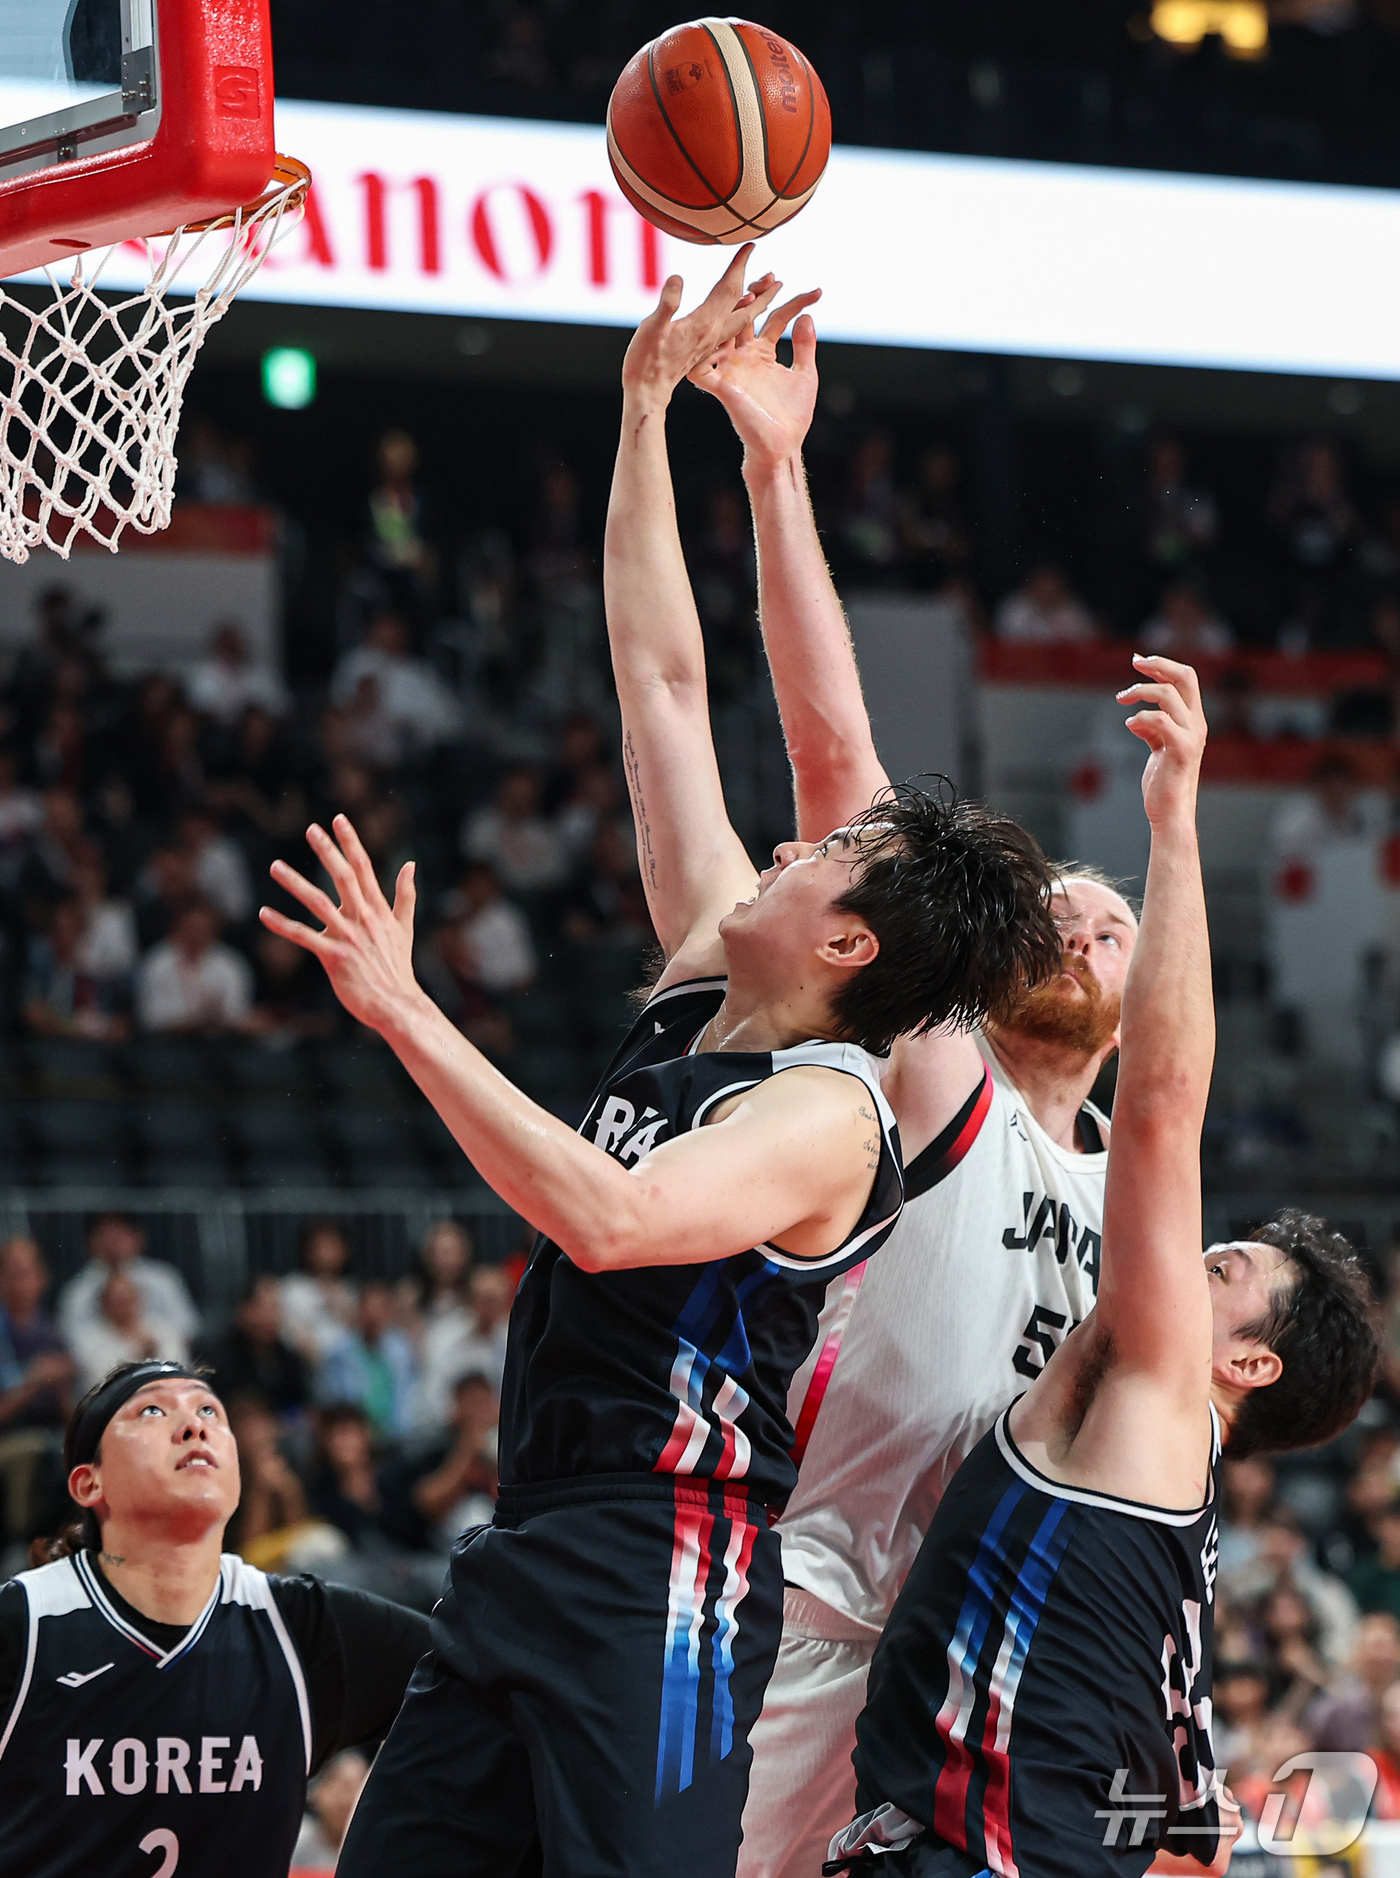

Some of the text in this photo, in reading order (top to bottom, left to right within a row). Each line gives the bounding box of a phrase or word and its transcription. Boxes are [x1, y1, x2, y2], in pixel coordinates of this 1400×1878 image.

[755, 28, 797, 114] molten
[118, 169, 665, 295] anon
[1001, 1191, 1102, 1298] JAPA
[1012, 1304, 1083, 1381] 5
[63, 1734, 265, 1797] KOREA
[138, 1827, 180, 1878] 2
